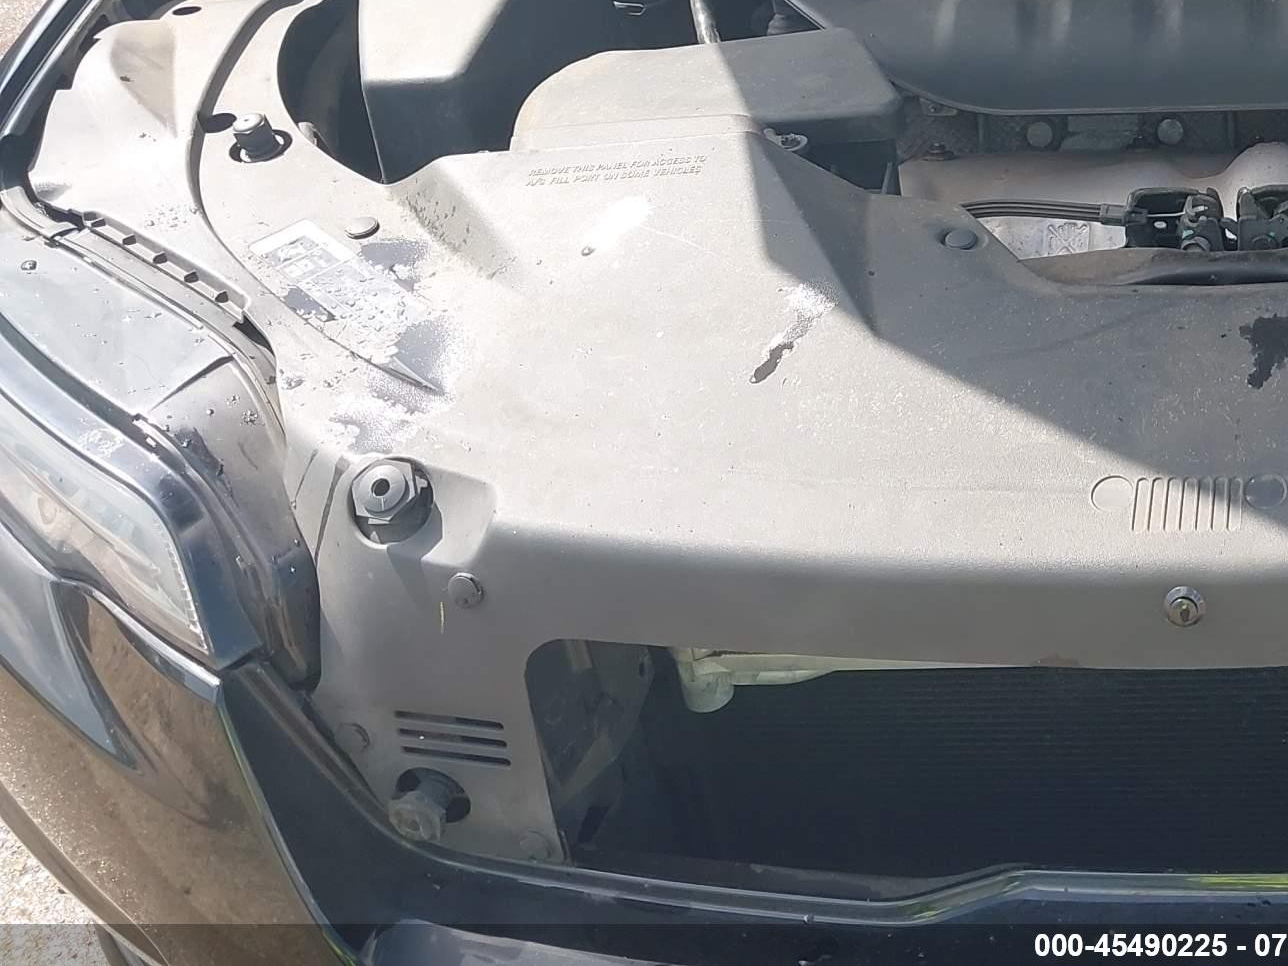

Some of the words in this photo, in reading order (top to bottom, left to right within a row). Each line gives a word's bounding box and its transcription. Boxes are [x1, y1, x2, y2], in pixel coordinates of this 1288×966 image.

[528, 166, 570, 176] REMOVE
[572, 164, 595, 173] THIS
[596, 161, 627, 172] PANEL
[630, 160, 650, 169] FOR
[651, 156, 692, 167] ACCESS
[693, 155, 707, 163] TO
[550, 175, 570, 185] FILL
[573, 173, 600, 183] PORT
[603, 172, 619, 181] ON
[620, 169, 650, 180] SOME
[652, 165, 703, 177] VEHICLES
